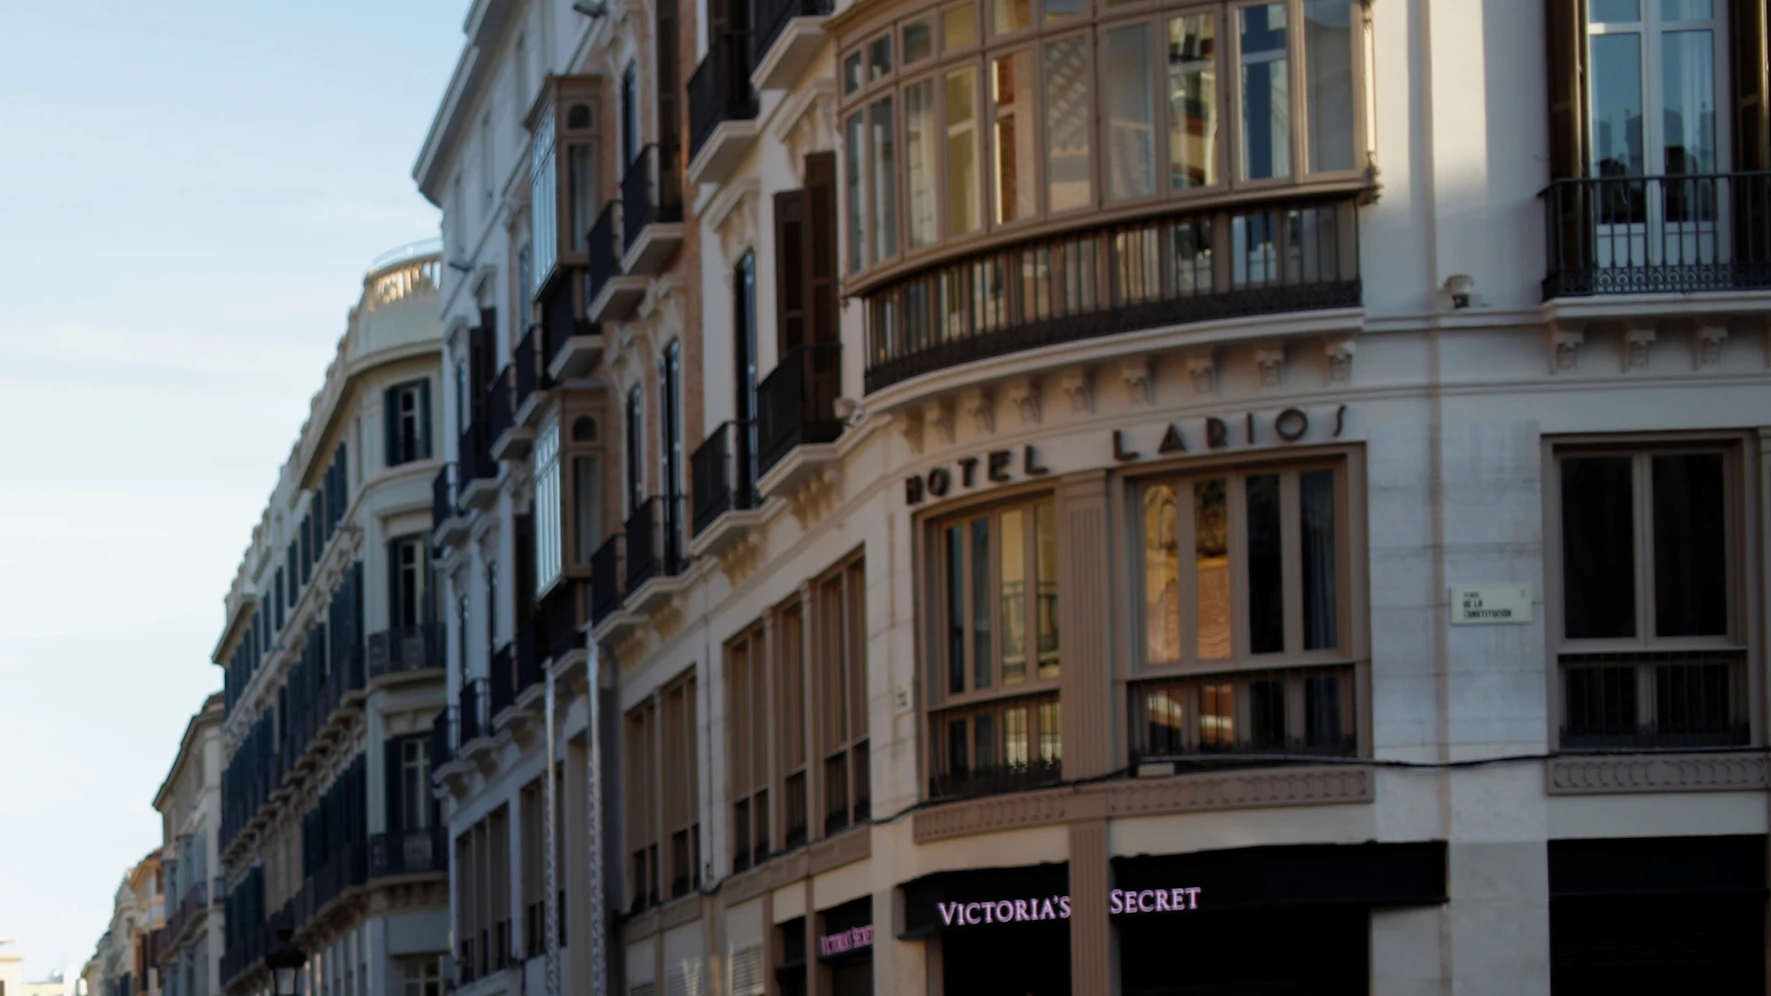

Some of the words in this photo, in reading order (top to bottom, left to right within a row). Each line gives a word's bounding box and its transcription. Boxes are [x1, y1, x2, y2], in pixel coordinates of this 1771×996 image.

[906, 445, 1049, 505] HOTEL
[1113, 404, 1348, 461] LARIOS
[938, 895, 1071, 926] VICTORIA'S
[1110, 887, 1202, 915] SECRET
